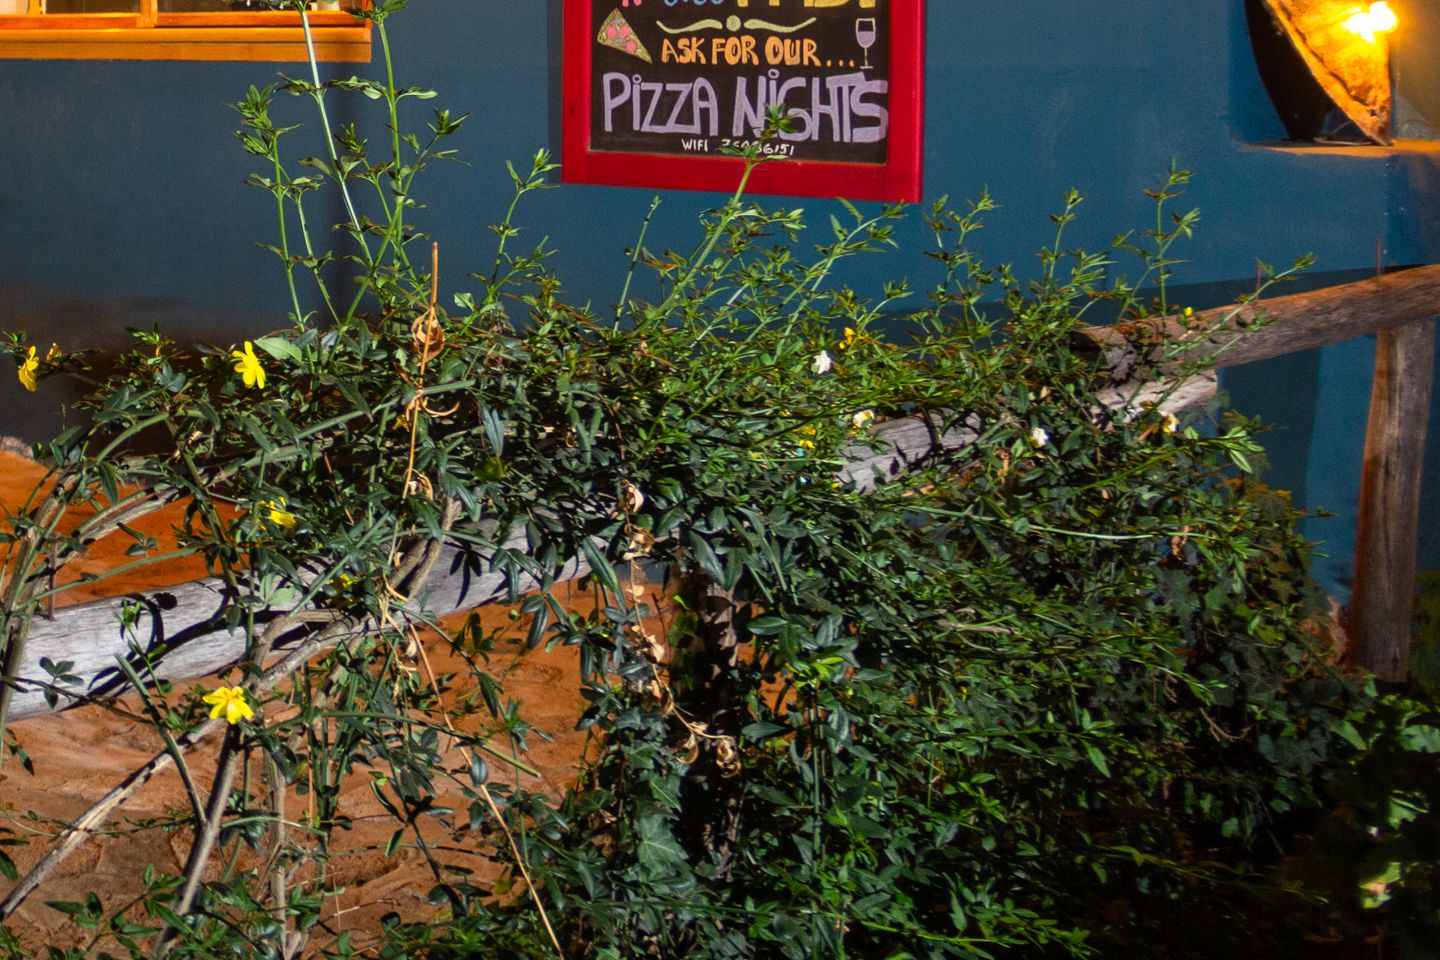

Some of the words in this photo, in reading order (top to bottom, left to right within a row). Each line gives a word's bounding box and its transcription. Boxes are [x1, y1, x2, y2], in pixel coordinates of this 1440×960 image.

[661, 36, 707, 65] ASK
[711, 36, 760, 66] FOR
[681, 138, 709, 153] WIFI
